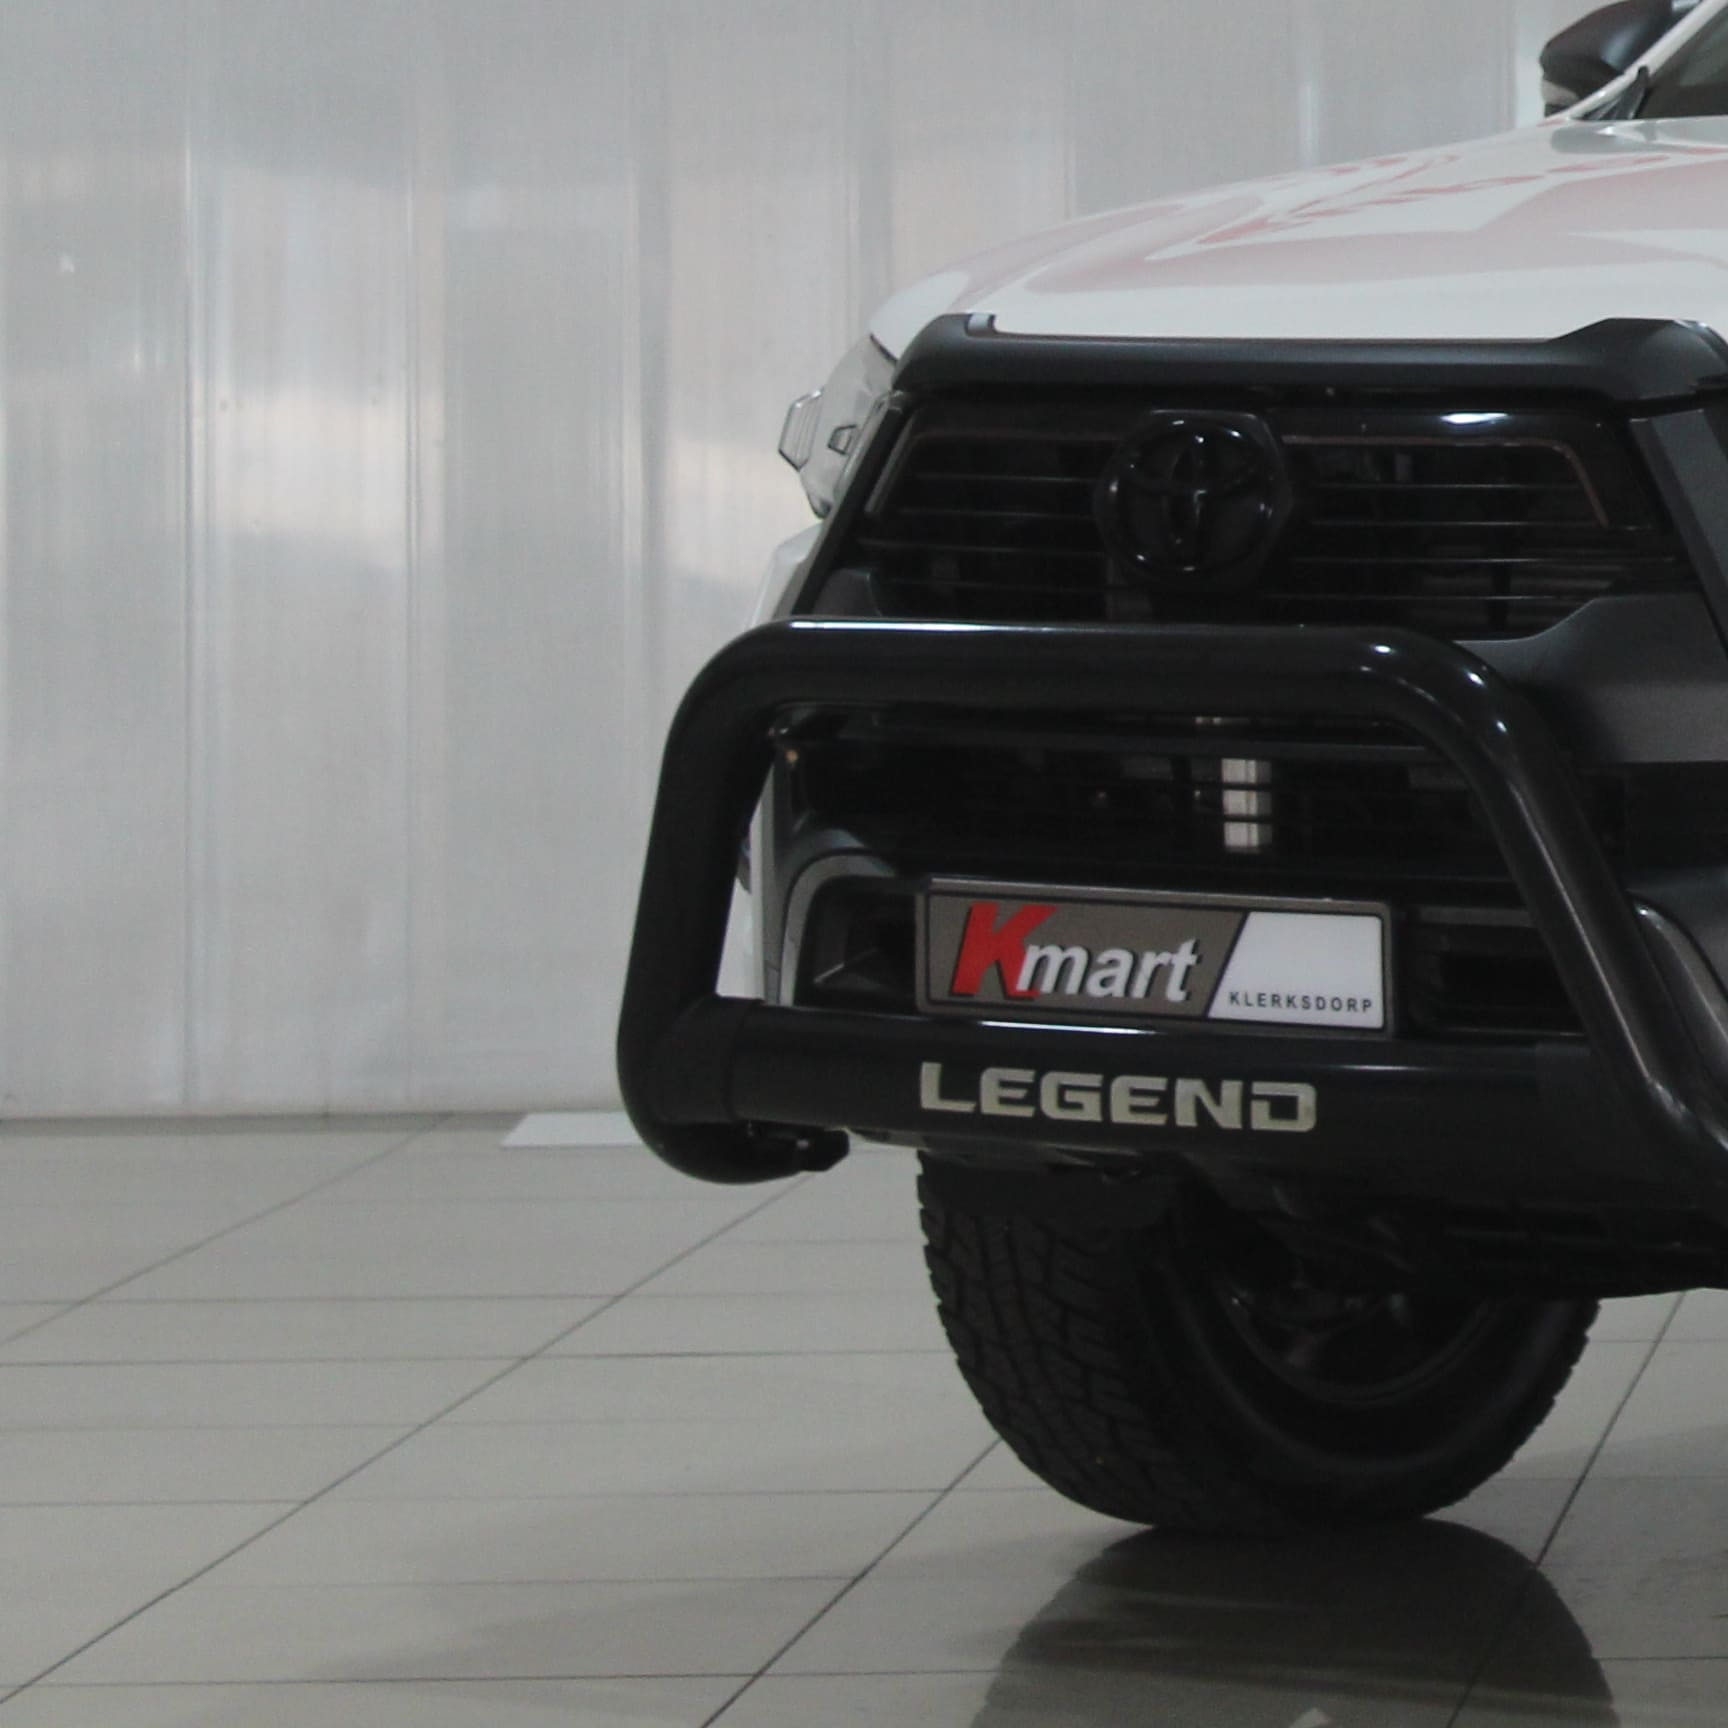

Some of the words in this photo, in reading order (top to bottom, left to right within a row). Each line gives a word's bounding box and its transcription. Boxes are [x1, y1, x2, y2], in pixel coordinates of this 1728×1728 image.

[950, 901, 1200, 1002] Kmart
[1228, 990, 1374, 1014] KLERKSDORP
[919, 1061, 1318, 1133] LEGEND
